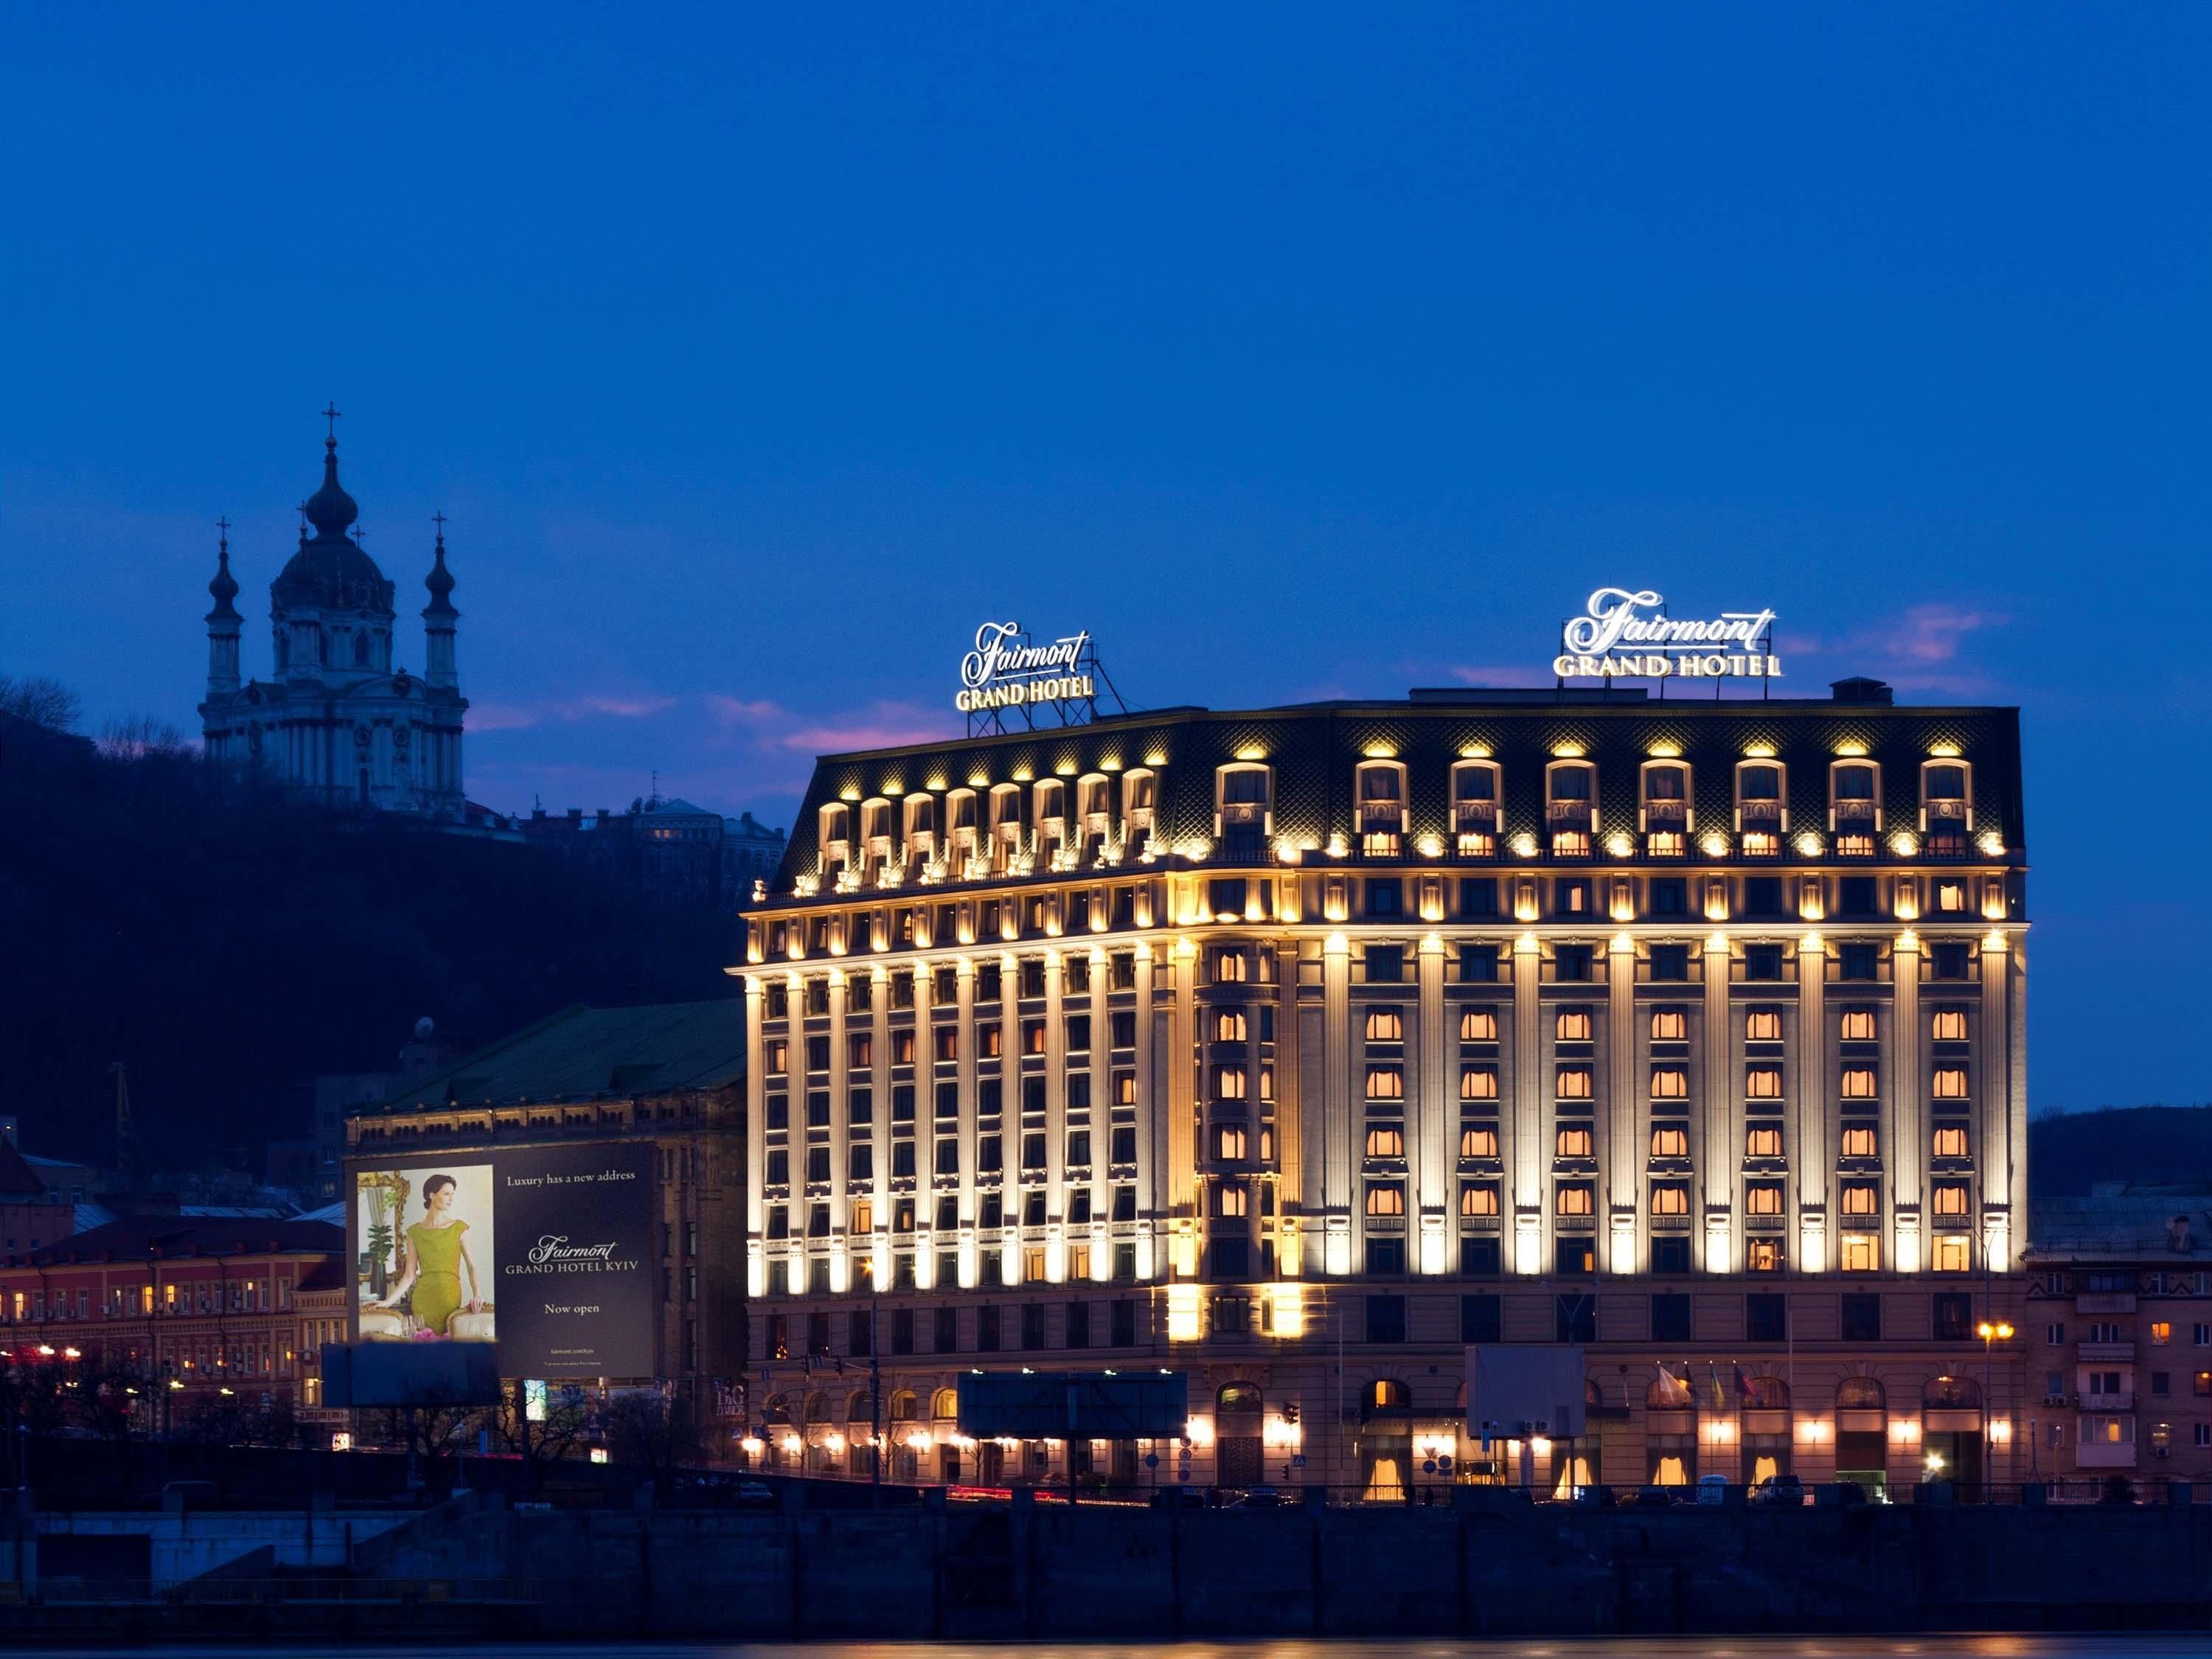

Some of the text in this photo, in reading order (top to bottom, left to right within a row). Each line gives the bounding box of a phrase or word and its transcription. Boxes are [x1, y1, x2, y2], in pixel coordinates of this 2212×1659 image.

[1564, 588, 1778, 655] Fairmont
[961, 622, 1091, 687] Fairmont
[1553, 655, 1783, 677] GRAND HOTEL
[956, 675, 1094, 712] GRAND HOTEL
[507, 1176, 543, 1187] Luxury
[546, 1174, 563, 1184] has
[574, 1174, 594, 1183] new
[597, 1169, 636, 1181] address
[529, 1235, 619, 1264] Fairmont
[505, 1260, 639, 1275] GRAND HOTEL KYIV
[545, 1304, 600, 1316] Now open
